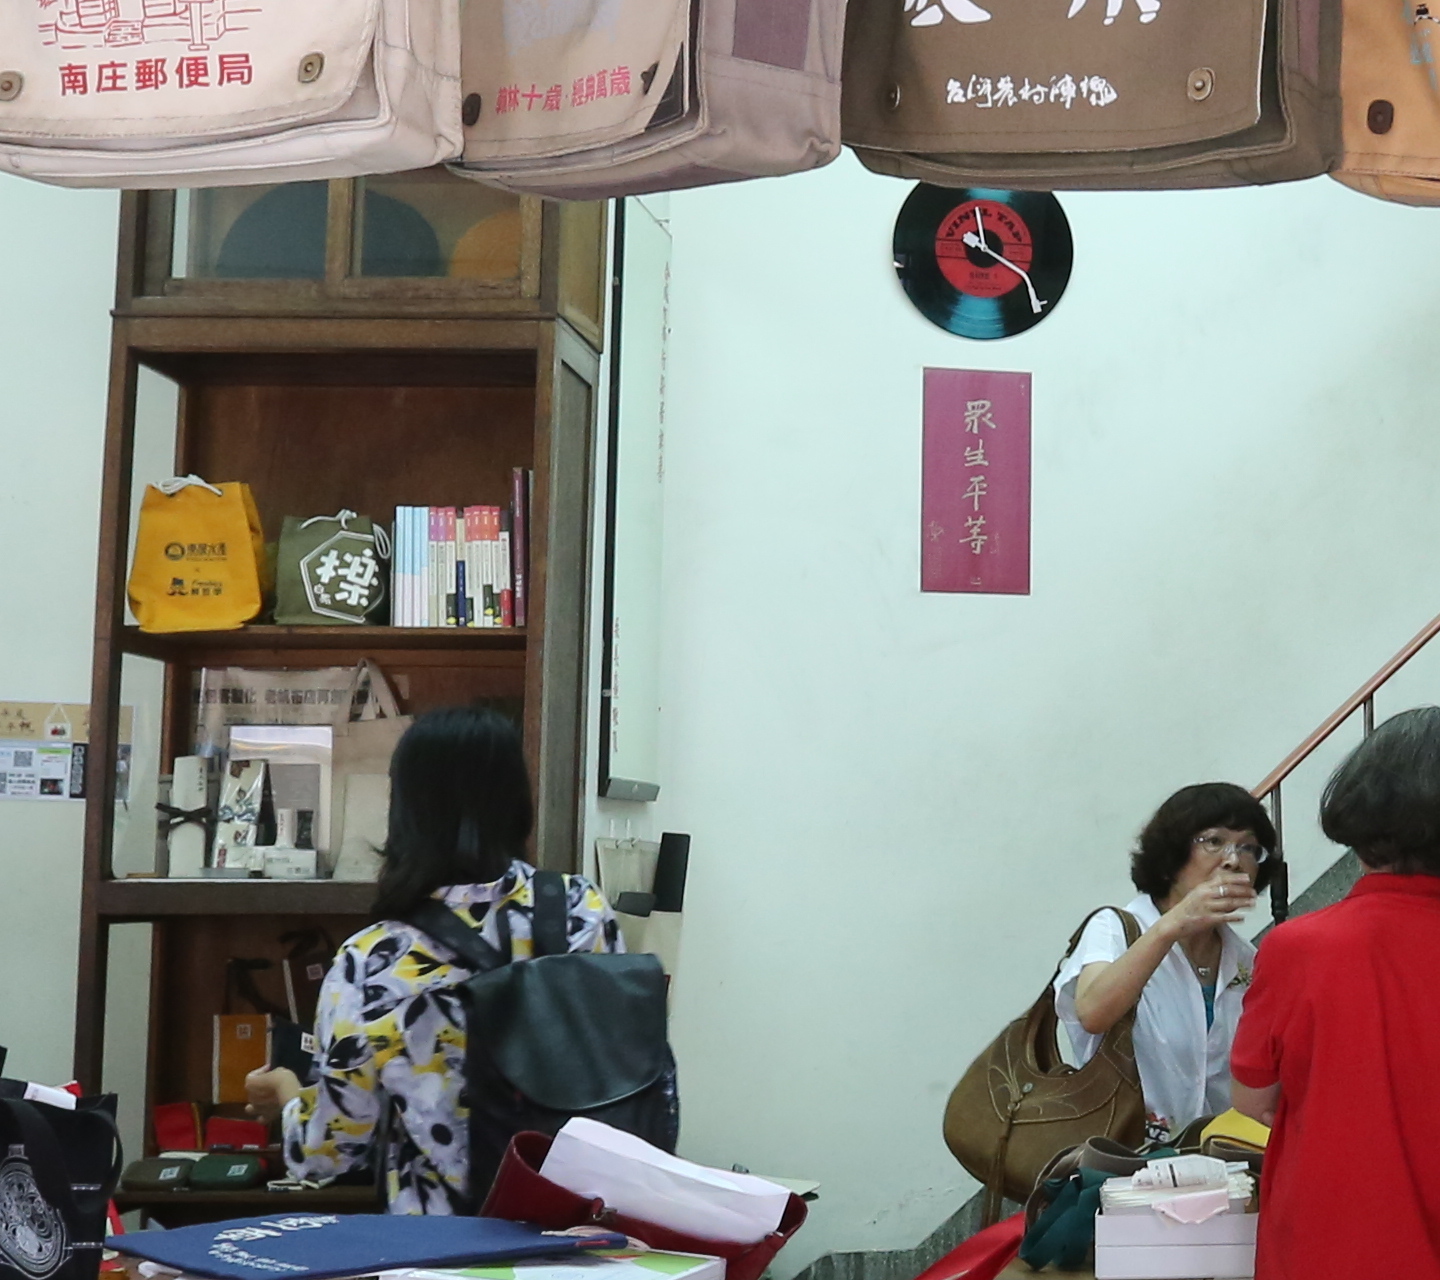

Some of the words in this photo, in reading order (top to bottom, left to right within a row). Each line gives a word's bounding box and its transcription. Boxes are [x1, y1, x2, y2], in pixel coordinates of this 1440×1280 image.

[58, 50, 254, 96] 南庄郵便局
